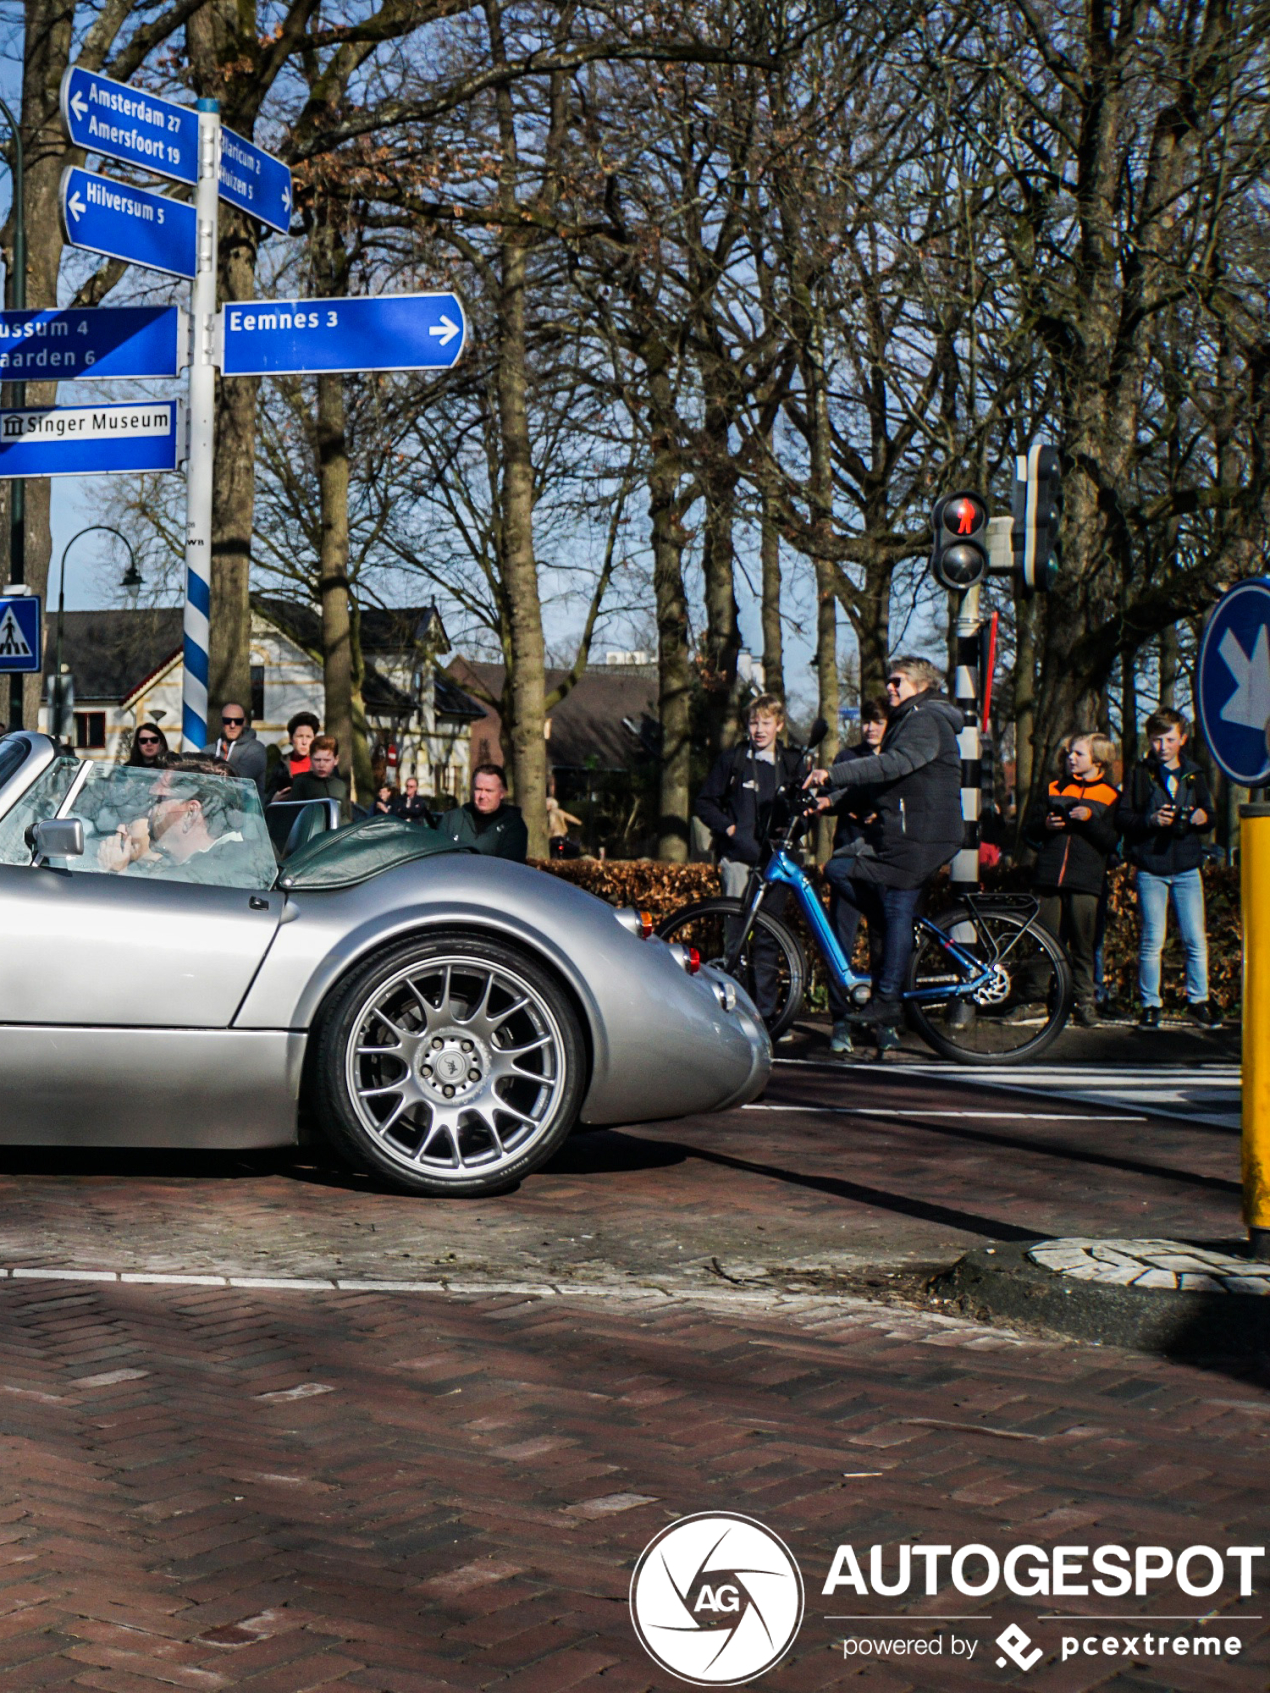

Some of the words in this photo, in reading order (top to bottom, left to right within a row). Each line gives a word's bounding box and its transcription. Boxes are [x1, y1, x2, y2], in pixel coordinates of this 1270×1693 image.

[89, 83, 164, 128] Amsterdam
[167, 115, 181, 133] 27
[89, 115, 164, 159] Amersfoort
[167, 146, 180, 165] 19
[255, 159, 261, 175] 2
[248, 184, 253, 200] 5
[86, 181, 154, 221] Hilversum
[157, 208, 165, 225] 5
[77, 320, 89, 335] 4
[230, 311, 319, 331] Eemnes
[326, 311, 338, 327] 3
[85, 350, 96, 365] 6
[27, 416, 85, 436] Singer
[92, 413, 168, 430] Museum
